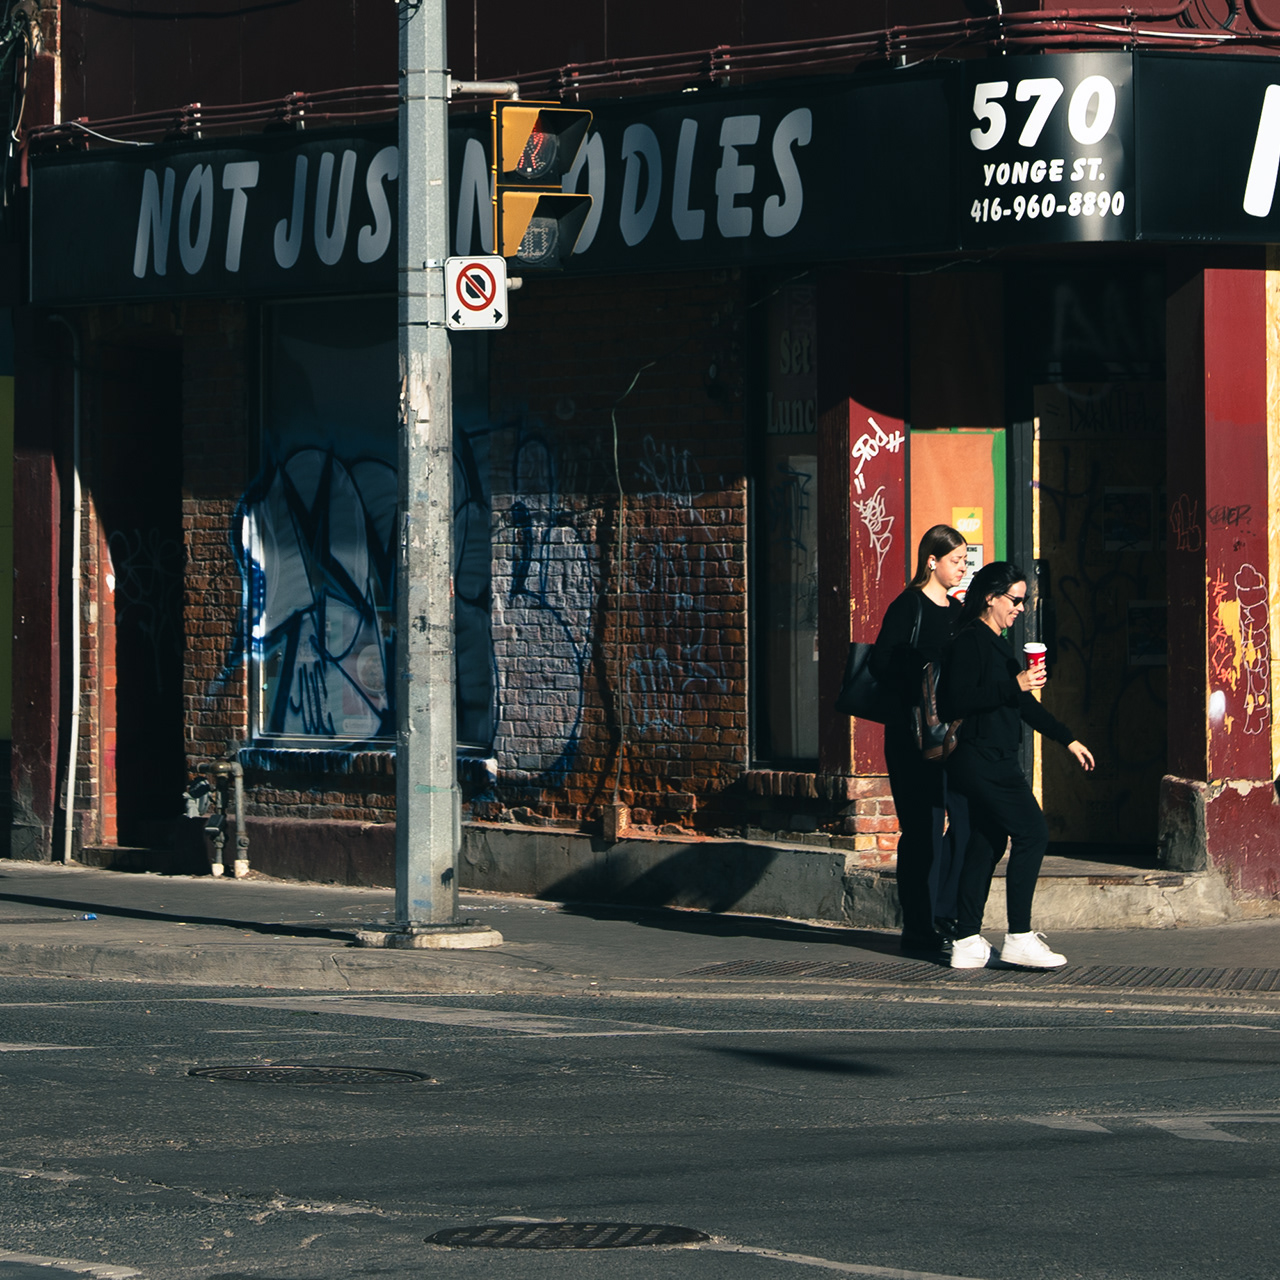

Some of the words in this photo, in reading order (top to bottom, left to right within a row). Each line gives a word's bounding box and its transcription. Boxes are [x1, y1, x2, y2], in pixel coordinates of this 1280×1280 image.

[970, 75, 1116, 151] 570
[132, 161, 260, 279] NOT
[272, 145, 399, 271] JUS
[455, 108, 813, 256] NODLES
[983, 159, 1065, 187] YONGE
[1070, 157, 1106, 182] ST.
[970, 190, 1125, 223] 416-960-8890
[780, 330, 811, 376] Set
[766, 389, 818, 435] Lunc
